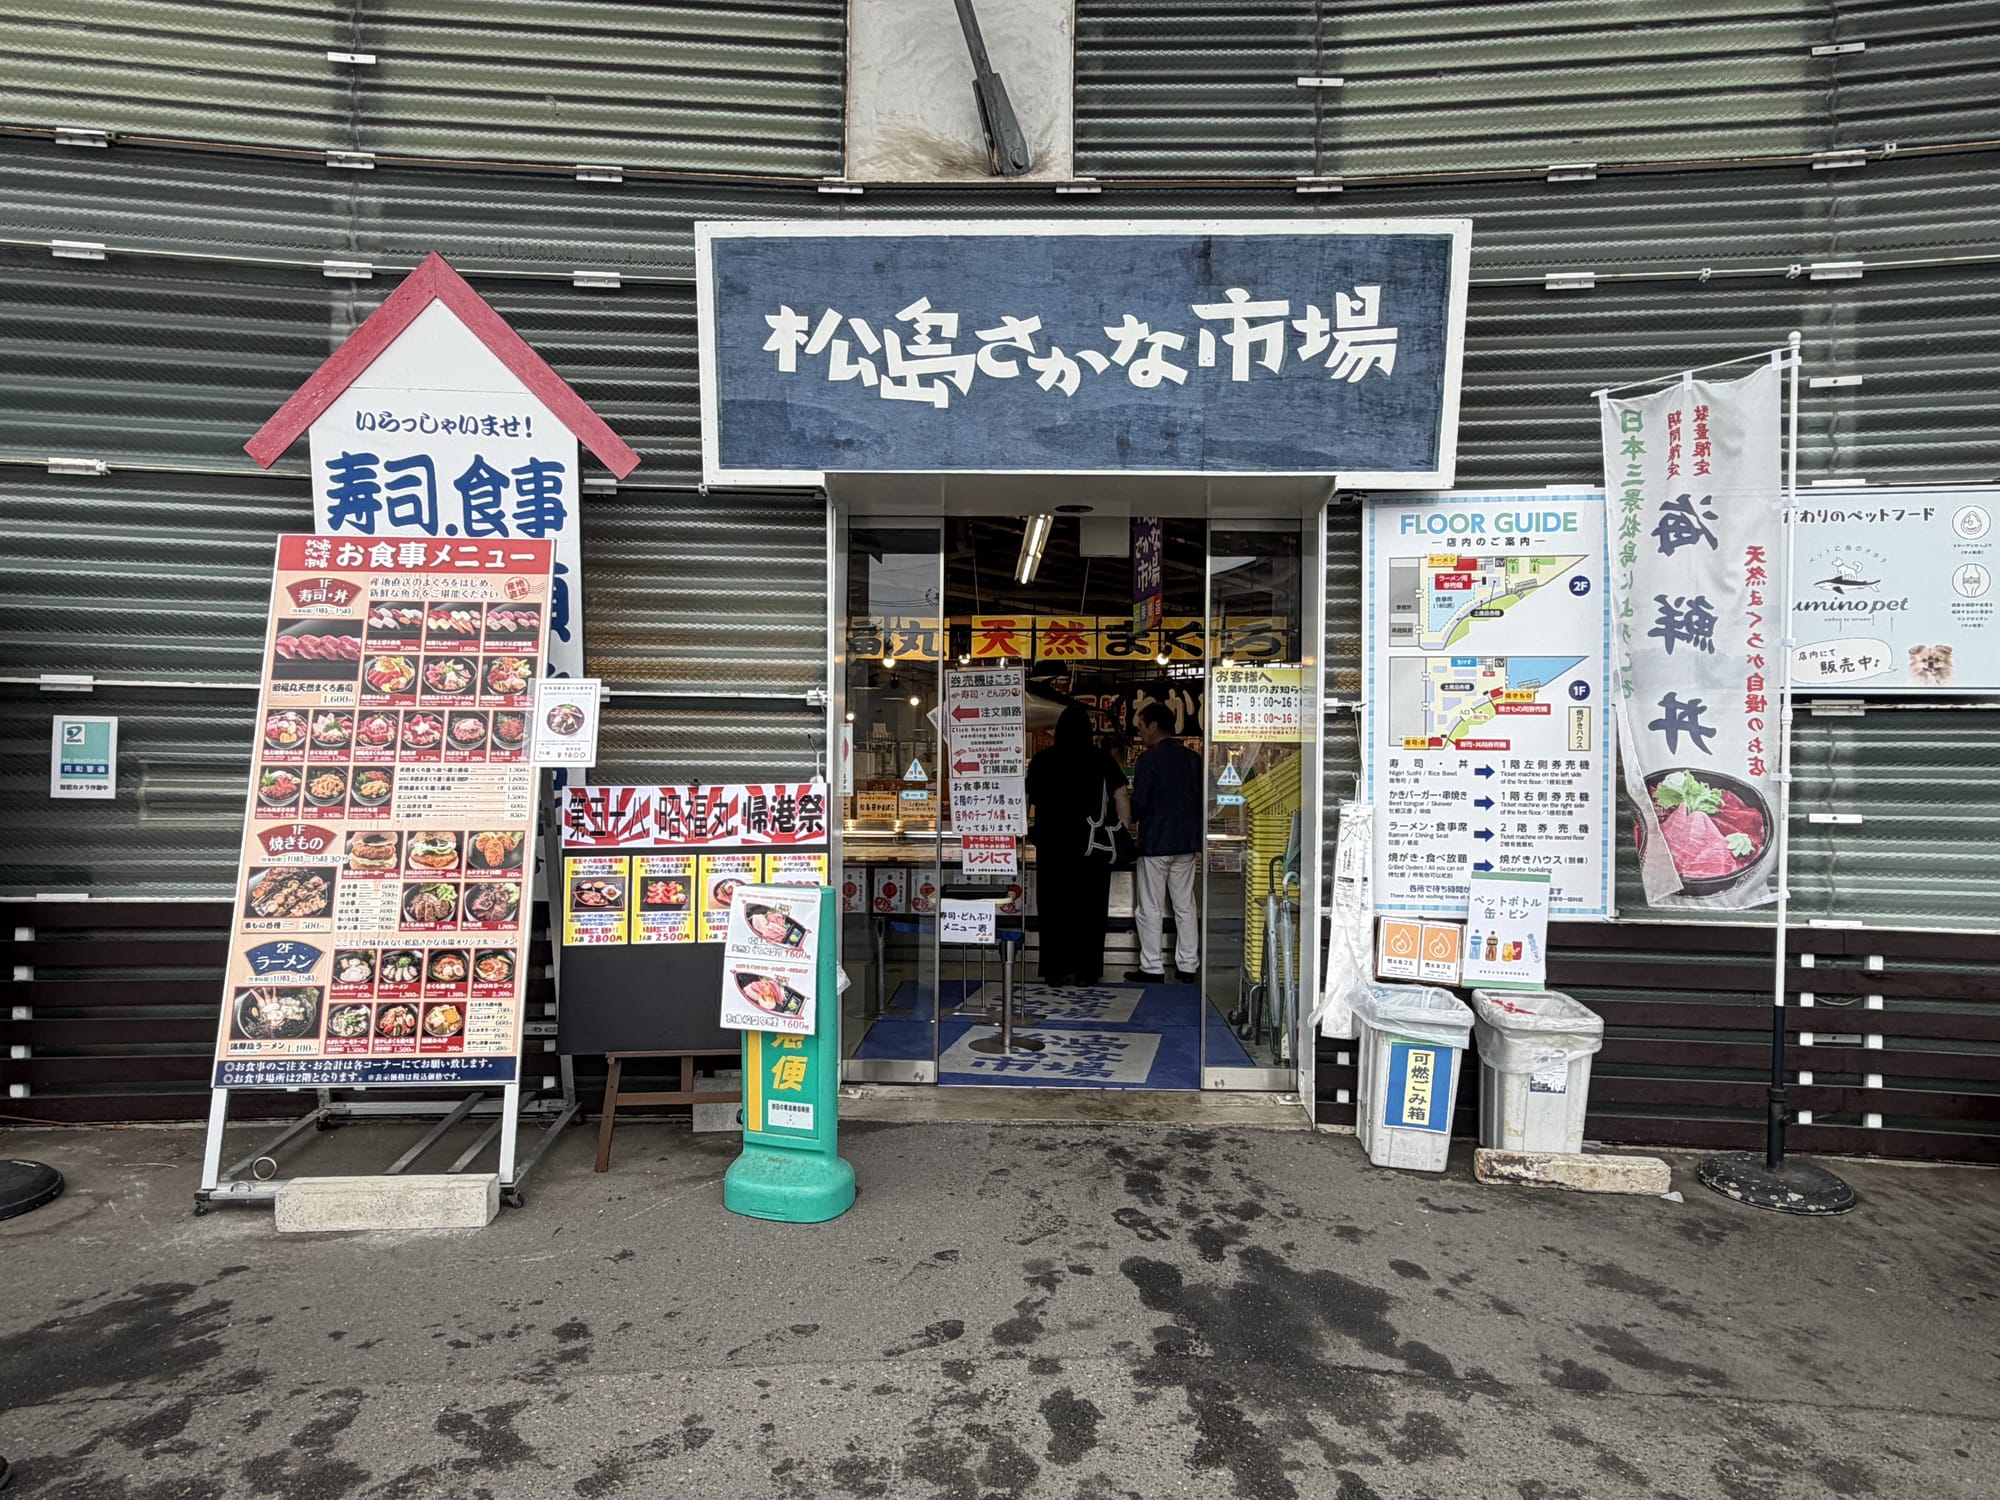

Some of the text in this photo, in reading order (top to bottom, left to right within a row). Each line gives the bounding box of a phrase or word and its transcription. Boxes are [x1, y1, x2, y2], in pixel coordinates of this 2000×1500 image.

[763, 285, 1398, 409] 松島さかな市場
[355, 410, 533, 438] いらっしゃいませ!
[1400, 511, 1578, 535] FLOOR GUIDE
[1446, 536, 1531, 548] 店内のご案内
[336, 541, 536, 570] お食事メニュー
[320, 579, 333, 588] 1F
[1572, 580, 1588, 591] 2F
[298, 588, 349, 603] 寿司・丼
[1798, 648, 1836, 661] 店内にて
[951, 673, 1021, 688] 券売機はこちら
[1216, 671, 1273, 683] お客様へ
[1572, 686, 1586, 696] 1F
[981, 706, 1021, 718] 注文順路
[1501, 759, 1590, 770] 1階左側券売機
[953, 781, 1000, 792] お食事席は
[1389, 790, 1468, 801] かきバーガー・串焼き
[1501, 791, 1590, 802] 1階右側券売機
[292, 825, 307, 835] 1F
[956, 823, 1017, 833] なっております。
[1389, 821, 1468, 832] ラーメン・食事席
[269, 836, 324, 851] 焼きもの
[968, 851, 1012, 865] レジにて
[1388, 853, 1468, 864] 焼がき・食べ放題
[1473, 896, 1542, 908] ペットボトル
[1484, 908, 1529, 920] 缶・ビン
[587, 934, 623, 943] 2800円
[655, 932, 690, 941] 2500円
[276, 943, 294, 953] 2F
[256, 955, 312, 970] ラーメン
[1407, 1052, 1431, 1121] 可燃ごみ箱
